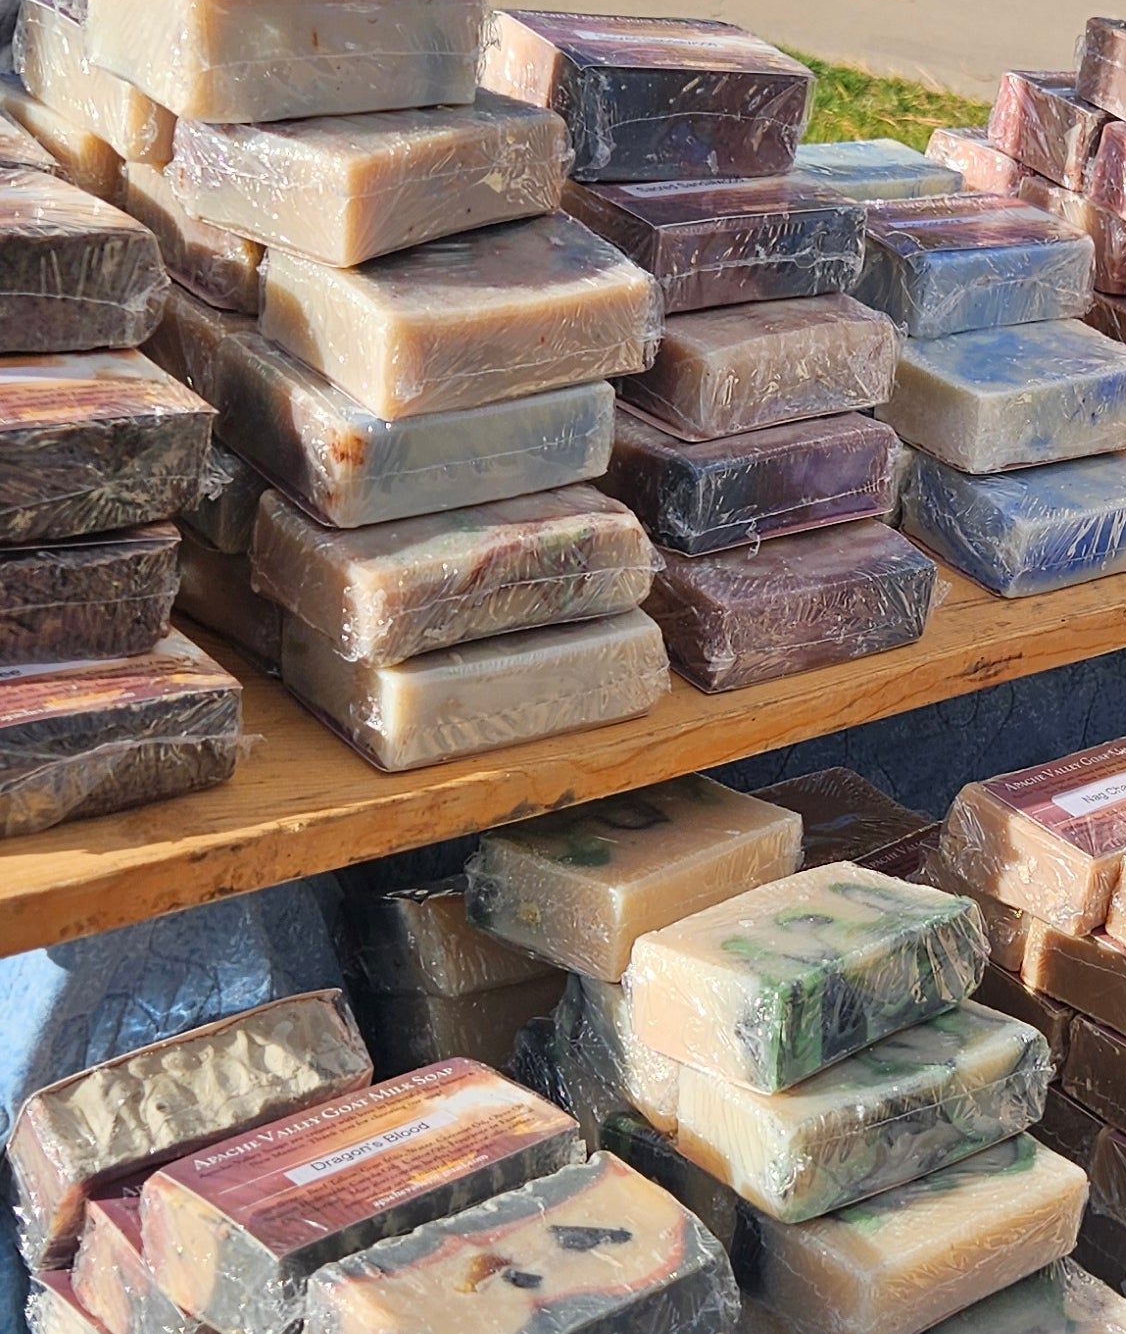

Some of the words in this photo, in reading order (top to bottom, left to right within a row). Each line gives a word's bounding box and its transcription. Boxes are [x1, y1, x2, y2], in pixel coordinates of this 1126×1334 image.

[1004, 774, 1047, 792] APACHE
[1041, 761, 1081, 778] VALLEY
[1080, 752, 1111, 767] GOAT
[1081, 791, 1109, 804] Nag
[193, 1139, 261, 1172] APACHE
[257, 1116, 321, 1142] VALLEY
[321, 1098, 369, 1119] GOAT
[370, 1081, 415, 1103] MILK
[411, 1067, 454, 1086] SOAP
[310, 1141, 384, 1171] Dragon's
[382, 1121, 431, 1144] Blood
